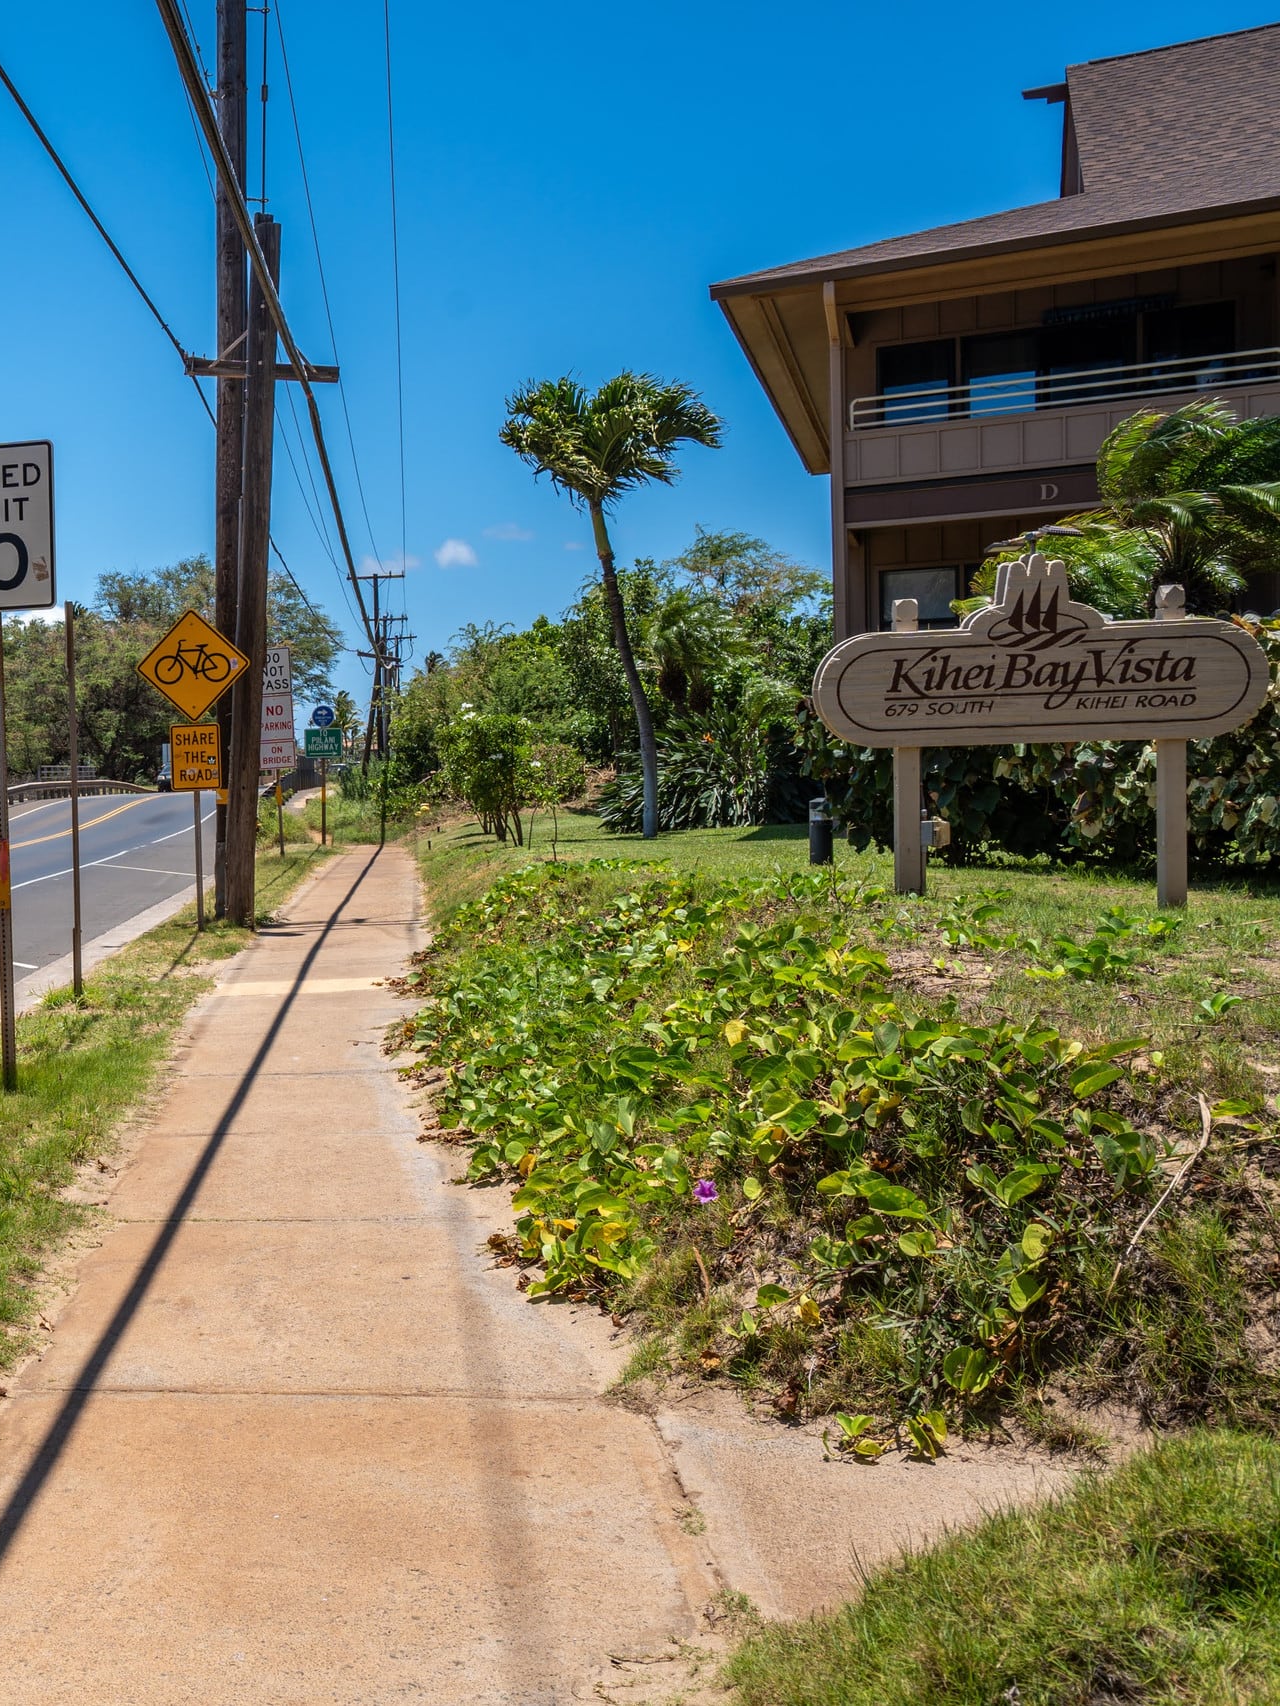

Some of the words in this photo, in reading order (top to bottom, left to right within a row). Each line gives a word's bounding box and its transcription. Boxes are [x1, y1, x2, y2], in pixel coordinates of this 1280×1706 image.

[1040, 483, 1059, 500] D
[263, 665, 284, 677] NOT
[886, 649, 996, 697] Kihei
[994, 653, 1089, 710] Bay
[1086, 640, 1197, 688] Vista
[266, 705, 283, 716] NO
[884, 704, 919, 717] 679
[925, 701, 995, 716] SOUTH
[1076, 696, 1128, 710] KIHEI
[1135, 694, 1197, 708] ROAD
[175, 732, 216, 746] SHARE
[271, 746, 283, 754] ON
[308, 743, 339, 752] HIGHWAY
[184, 751, 207, 763] THE
[262, 756, 292, 765] BRIDGE
[180, 769, 213, 781] ROAD
